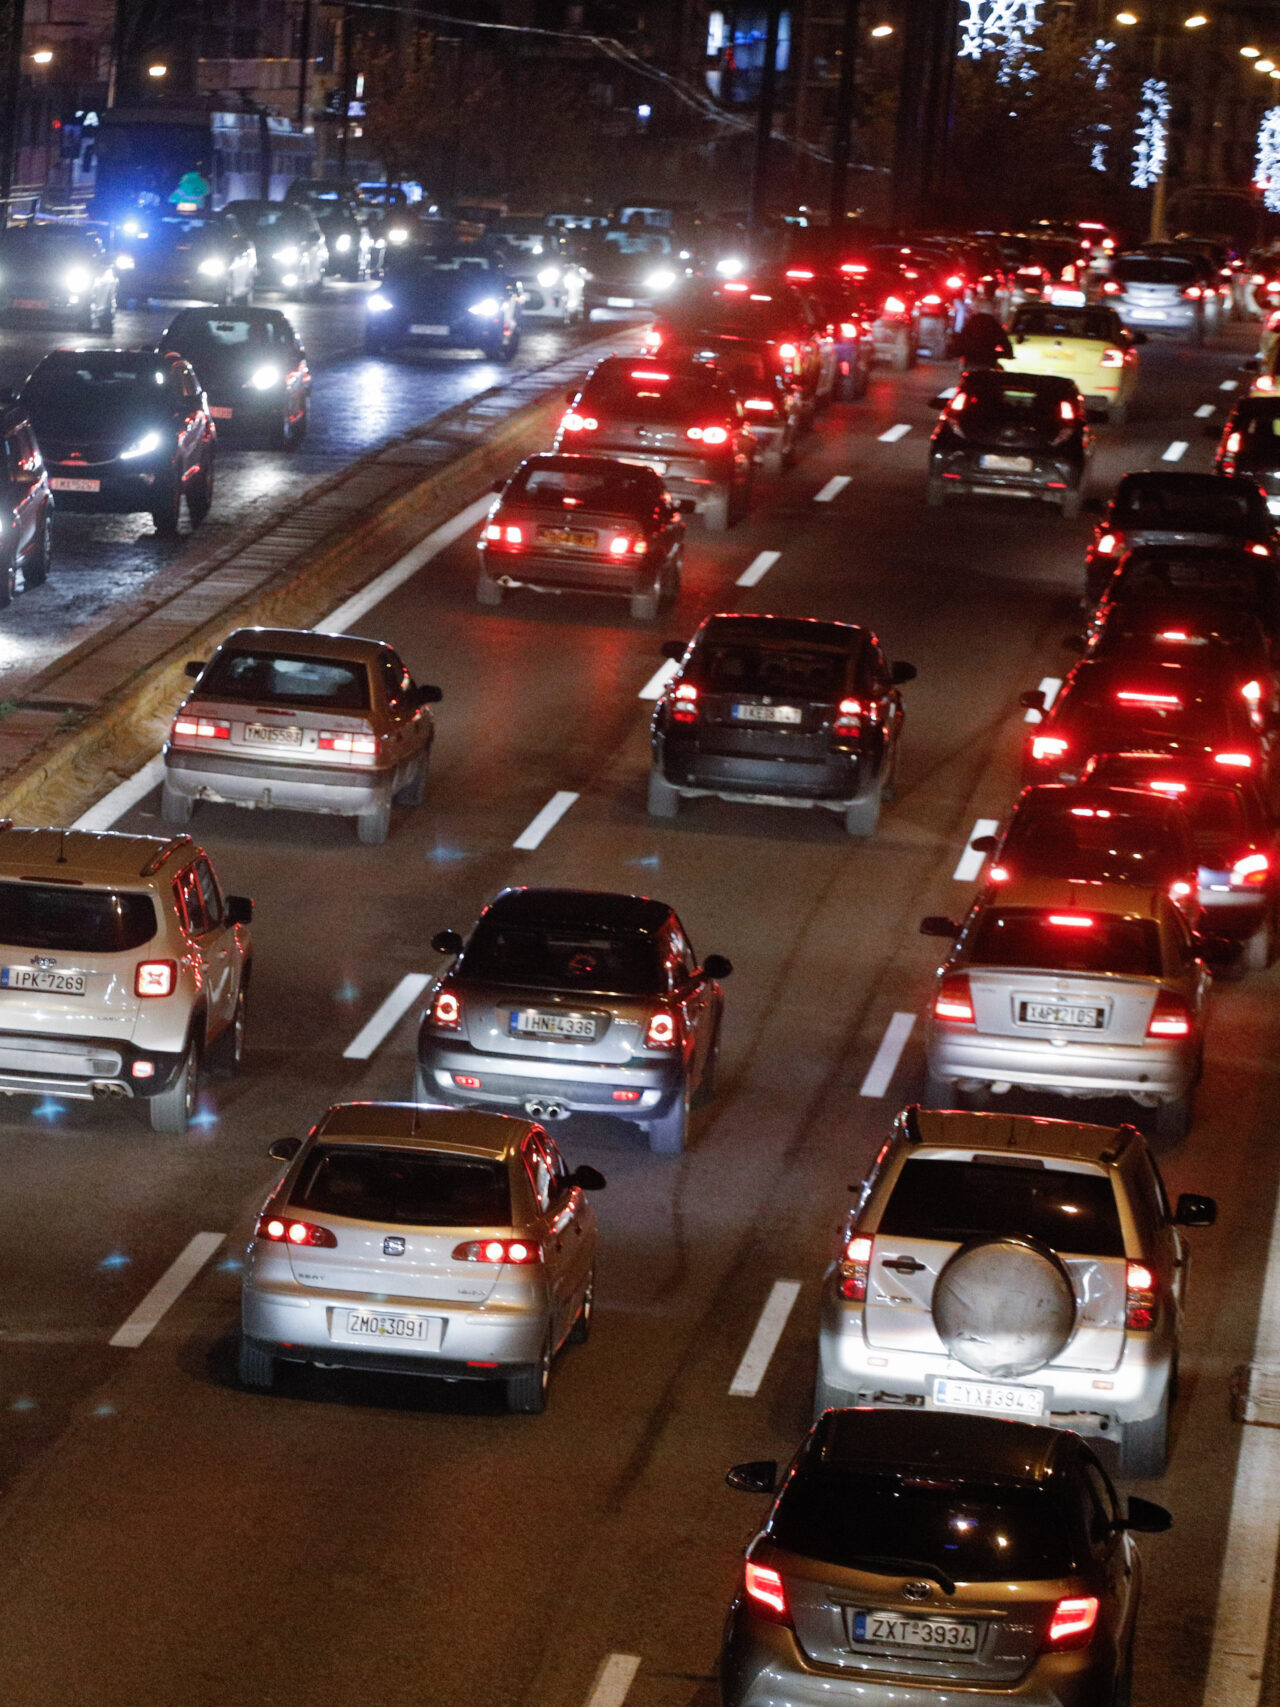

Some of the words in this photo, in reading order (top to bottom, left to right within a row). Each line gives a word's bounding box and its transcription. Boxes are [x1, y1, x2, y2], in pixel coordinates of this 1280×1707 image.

[14, 972, 84, 991] IPK-7269
[524, 1016, 593, 1035] IHN-4336
[350, 1315, 423, 1338] ZMO-3091
[871, 1619, 971, 1647] ZXT-3934
